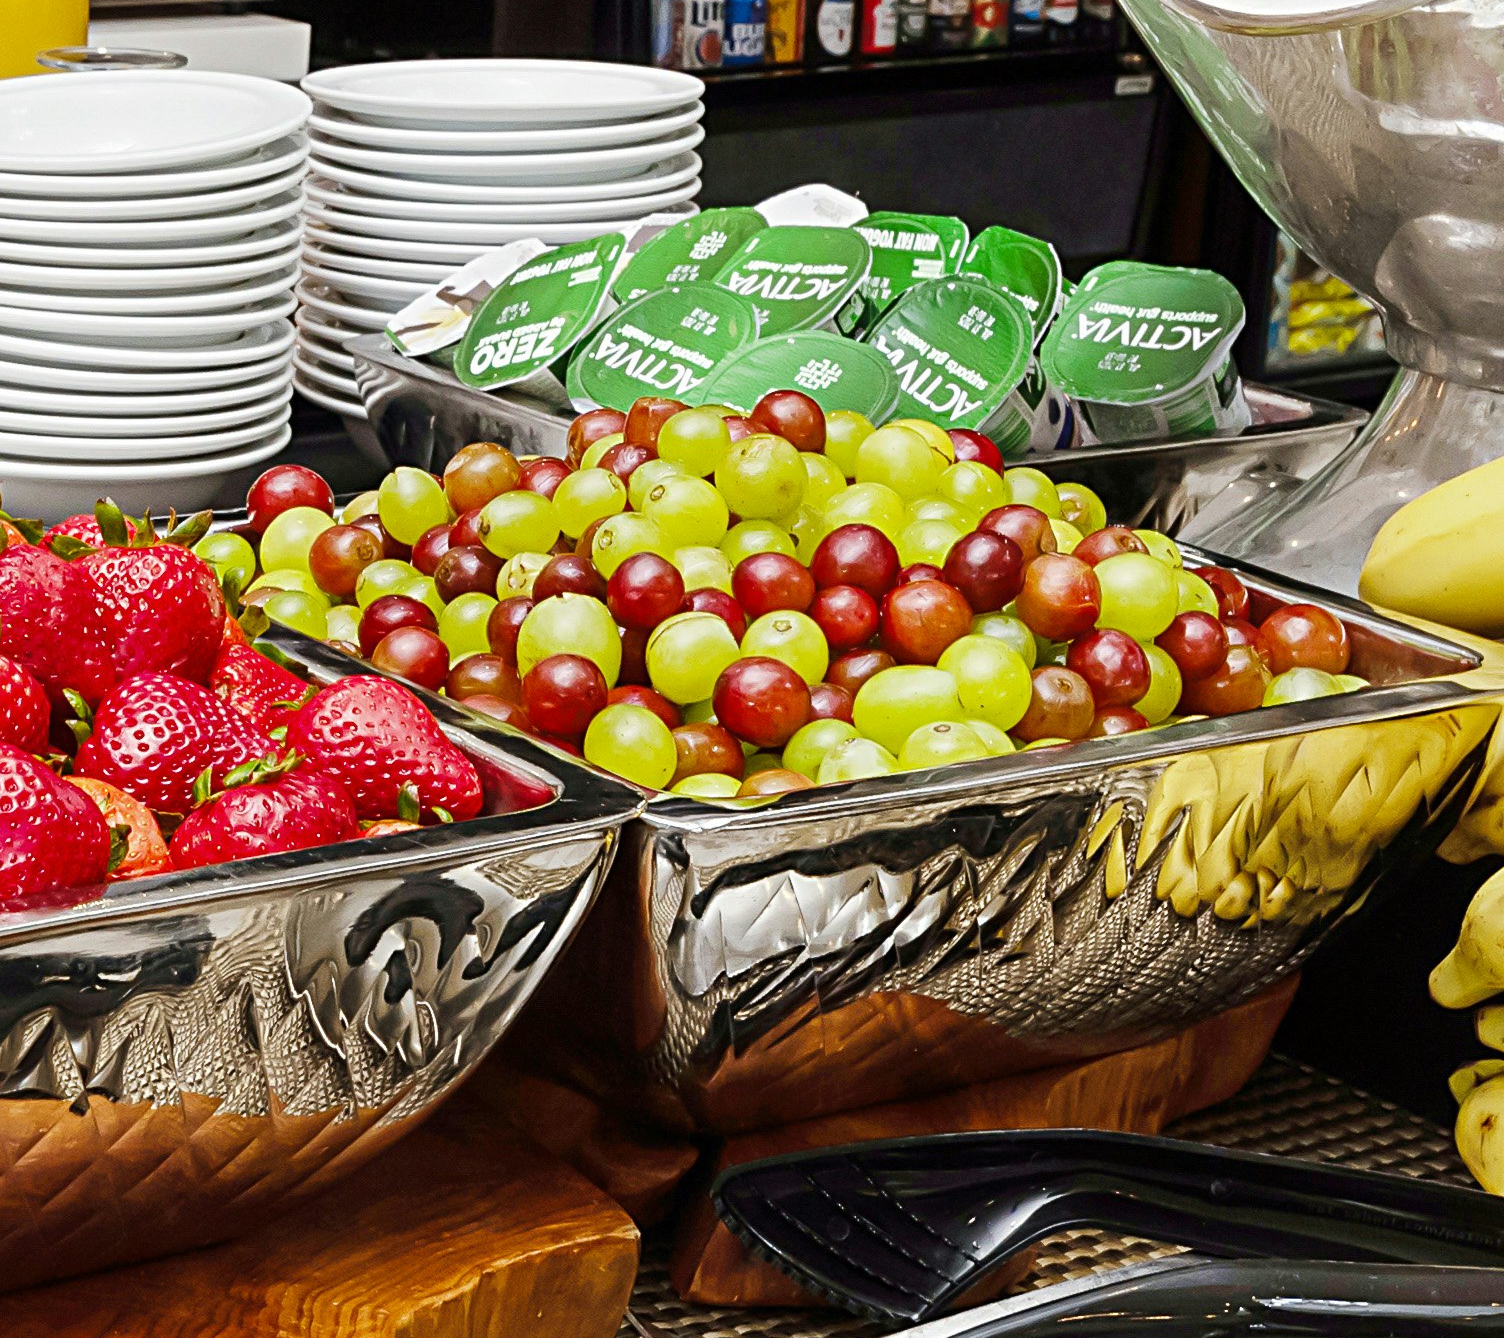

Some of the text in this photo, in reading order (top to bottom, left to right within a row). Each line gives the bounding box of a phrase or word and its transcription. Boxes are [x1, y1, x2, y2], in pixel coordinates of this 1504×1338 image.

[727, 272, 847, 300] ACTIVIA
[1137, 307, 1160, 319] gut
[1162, 310, 1218, 323] supports
[1077, 313, 1222, 351] ACTIVIA
[470, 327, 562, 375] ZERO
[593, 333, 704, 395] ACTIVIA
[927, 347, 950, 366] gut
[945, 359, 988, 390] supports
